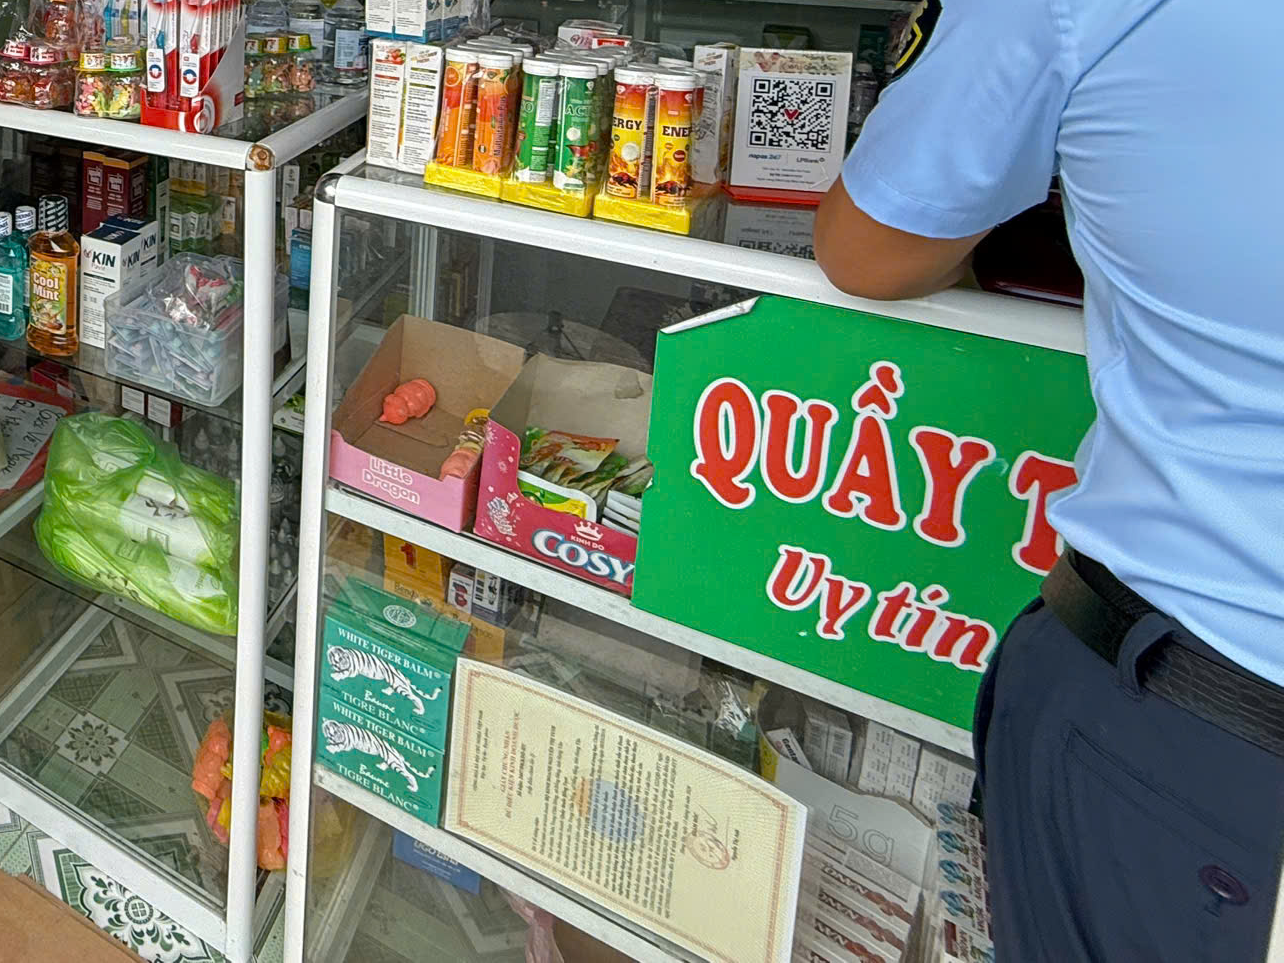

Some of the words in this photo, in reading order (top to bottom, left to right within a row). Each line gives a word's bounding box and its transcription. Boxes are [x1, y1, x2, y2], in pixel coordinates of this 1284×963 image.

[143, 232, 157, 251] KIN
[92, 251, 117, 269] KIN
[127, 248, 141, 268] KIN
[32, 284, 60, 301] Mint
[33, 272, 60, 290] Cool
[691, 362, 996, 547] QUẦY
[369, 455, 414, 486] Little
[362, 468, 421, 505] Dragon
[570, 534, 591, 546] KINH
[531, 527, 636, 586] COSY
[767, 544, 871, 641] Uy
[868, 582, 999, 673] tín
[337, 627, 370, 651] WHITE
[371, 644, 402, 666] TIGER
[341, 691, 376, 715] TIGRE
[363, 689, 396, 714] Baume
[332, 701, 364, 726] WHITE
[365, 719, 397, 742] TIGER
[336, 763, 371, 788] TIGRE
[358, 763, 390, 789] Baume
[827, 804, 895, 866] 5g
